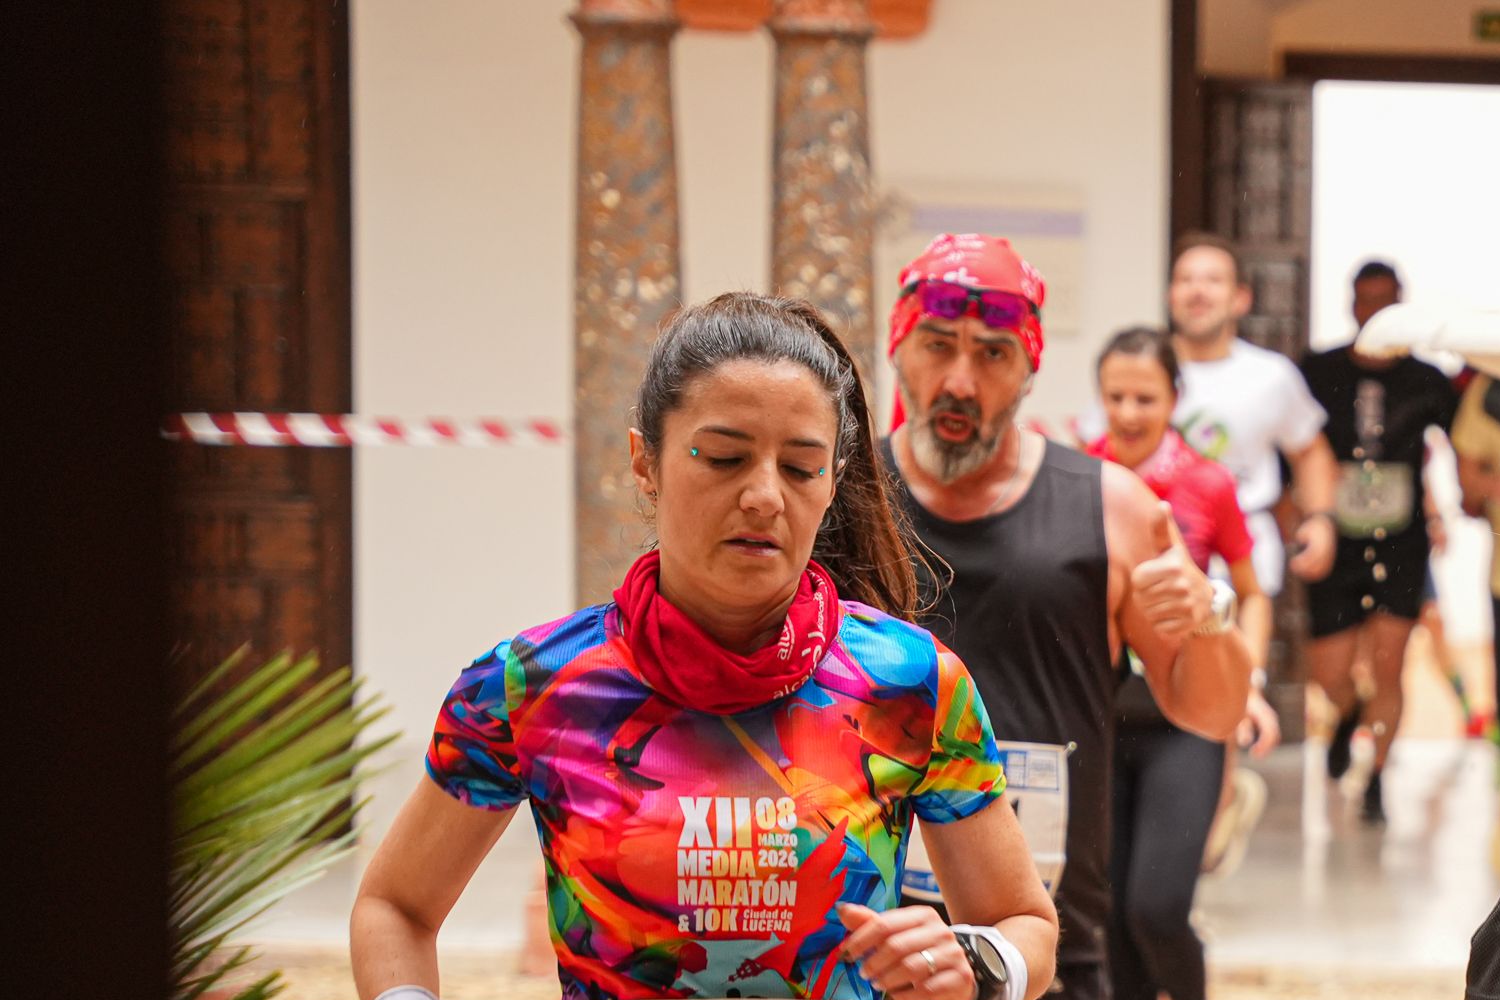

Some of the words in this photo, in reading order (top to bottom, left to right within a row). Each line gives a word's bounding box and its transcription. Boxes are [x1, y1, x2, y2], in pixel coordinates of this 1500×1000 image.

[677, 796, 753, 848] XII
[755, 797, 798, 830] 08
[757, 833, 798, 847] MARZO
[677, 850, 756, 877] MEDIA
[757, 849, 799, 867] 2026
[677, 874, 798, 906] MARATÓN
[677, 914, 690, 932] &
[693, 908, 738, 932] 10K
[743, 909, 778, 919] Ciudad
[780, 909, 793, 920] de
[743, 919, 791, 933] LUCENA
